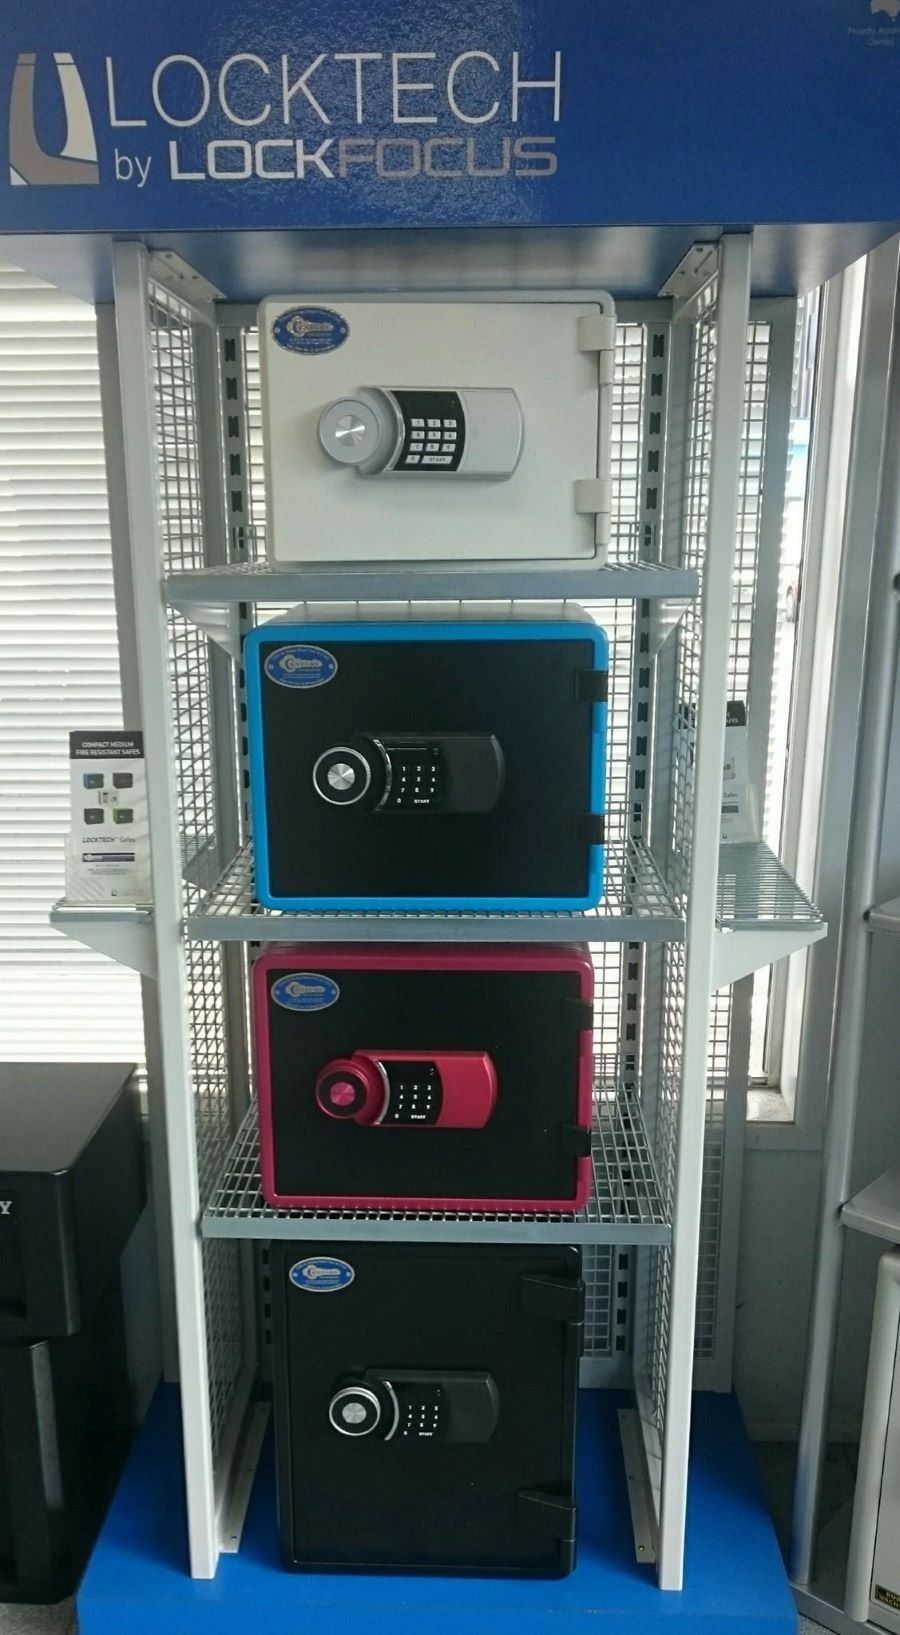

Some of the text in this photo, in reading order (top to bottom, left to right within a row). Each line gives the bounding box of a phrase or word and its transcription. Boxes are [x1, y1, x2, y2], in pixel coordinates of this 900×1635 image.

[106, 50, 561, 127] LOCKTECH
[114, 136, 558, 188] by LOCKFOCUS
